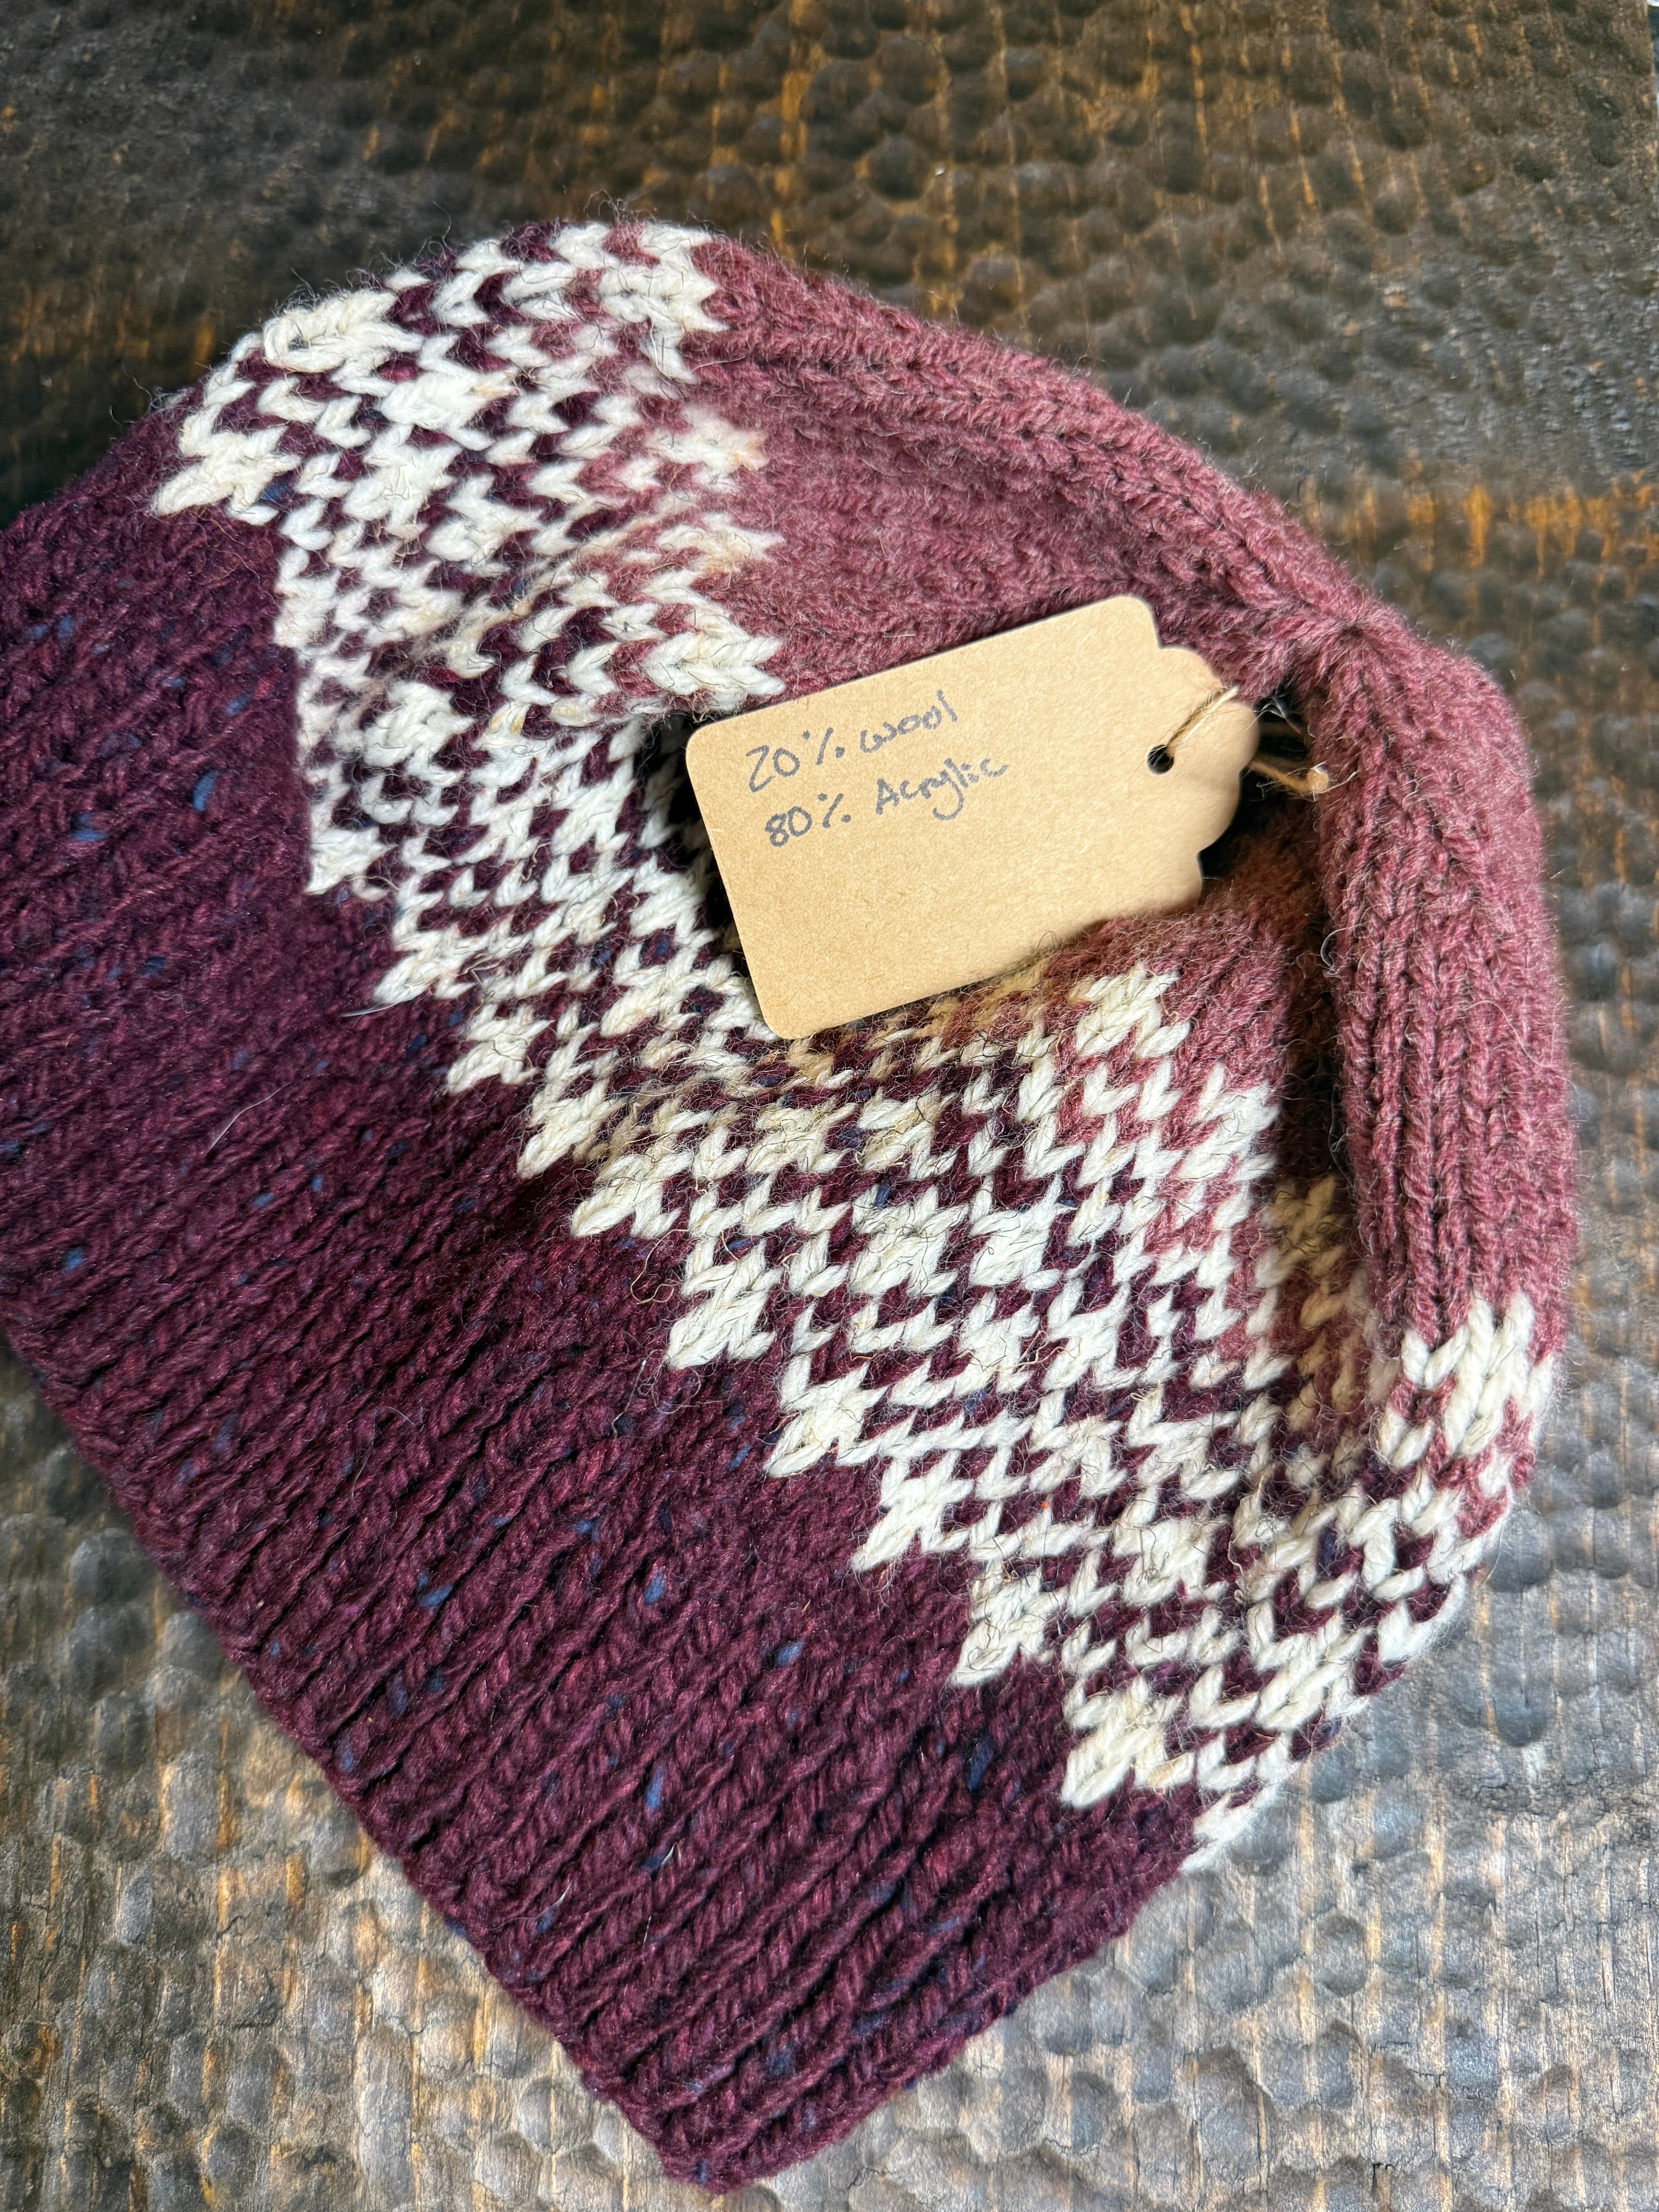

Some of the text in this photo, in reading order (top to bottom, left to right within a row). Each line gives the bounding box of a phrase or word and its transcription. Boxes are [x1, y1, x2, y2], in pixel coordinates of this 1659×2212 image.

[746, 727, 845, 792] 20%
[765, 758, 1008, 847] 80% Acrylic
